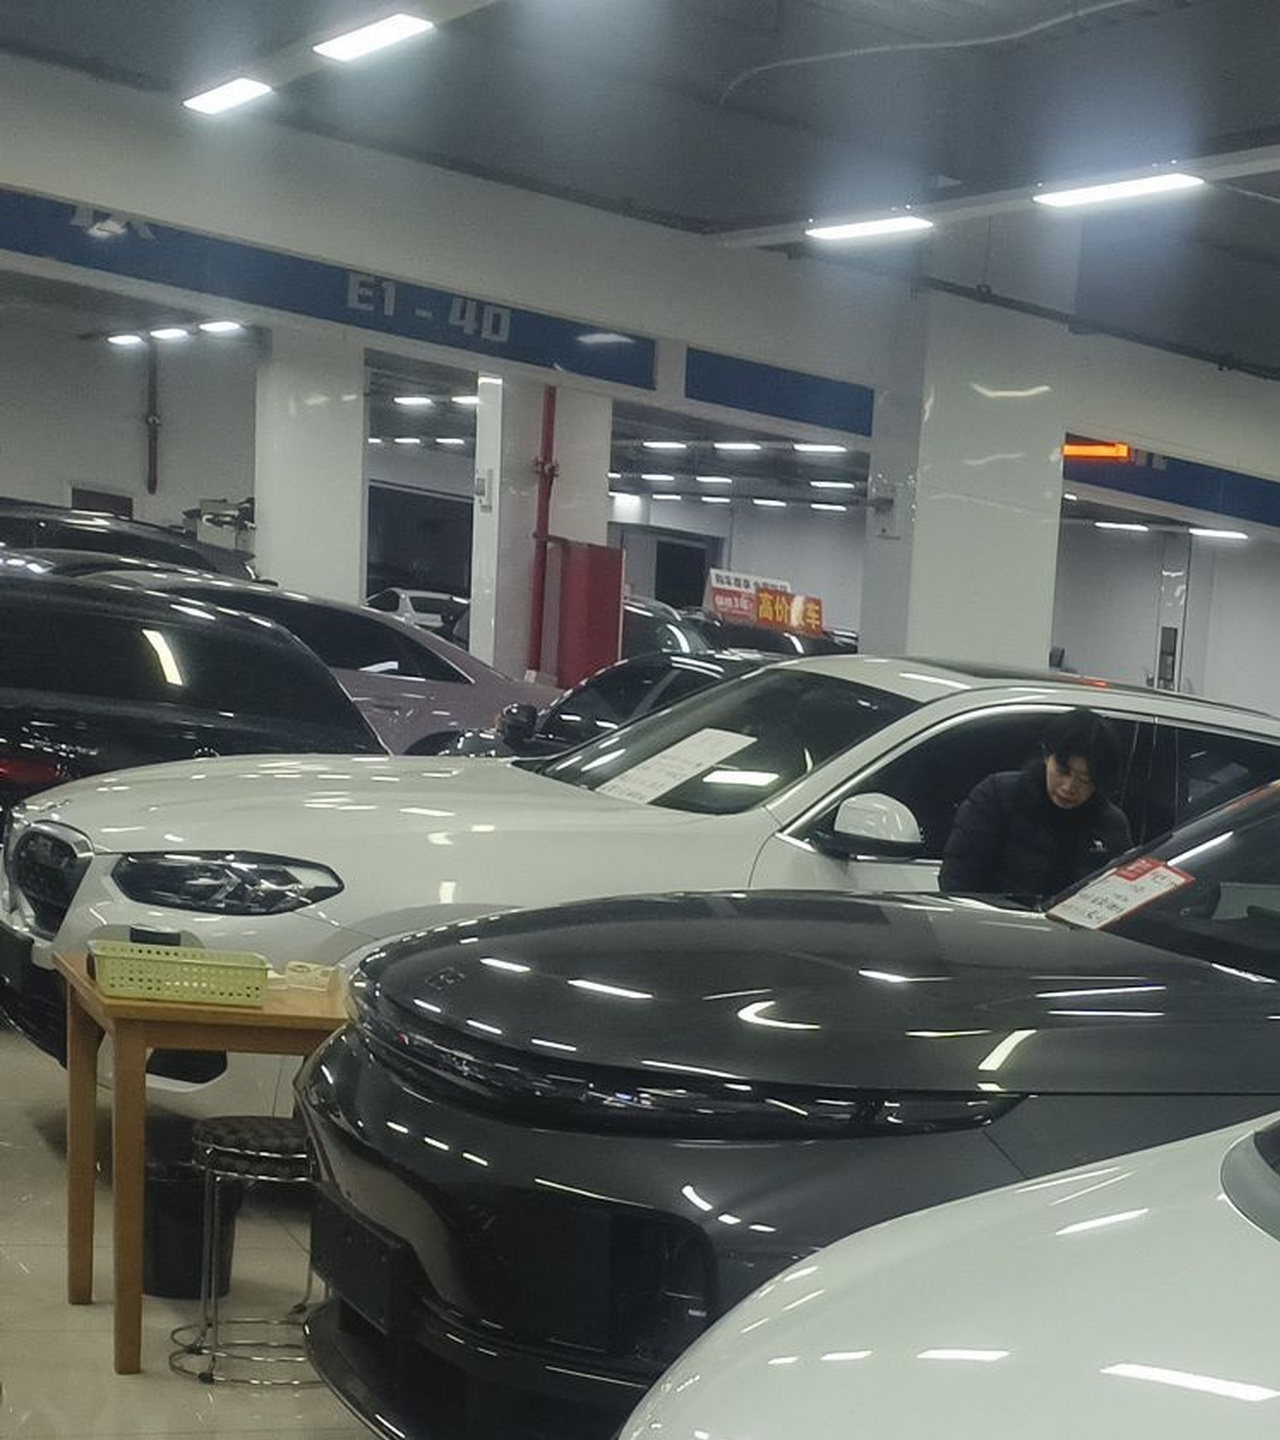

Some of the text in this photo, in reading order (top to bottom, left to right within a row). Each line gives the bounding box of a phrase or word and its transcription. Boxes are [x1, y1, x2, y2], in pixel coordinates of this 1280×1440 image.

[348, 272, 396, 316] E1
[758, 592, 820, 629] 高价车
